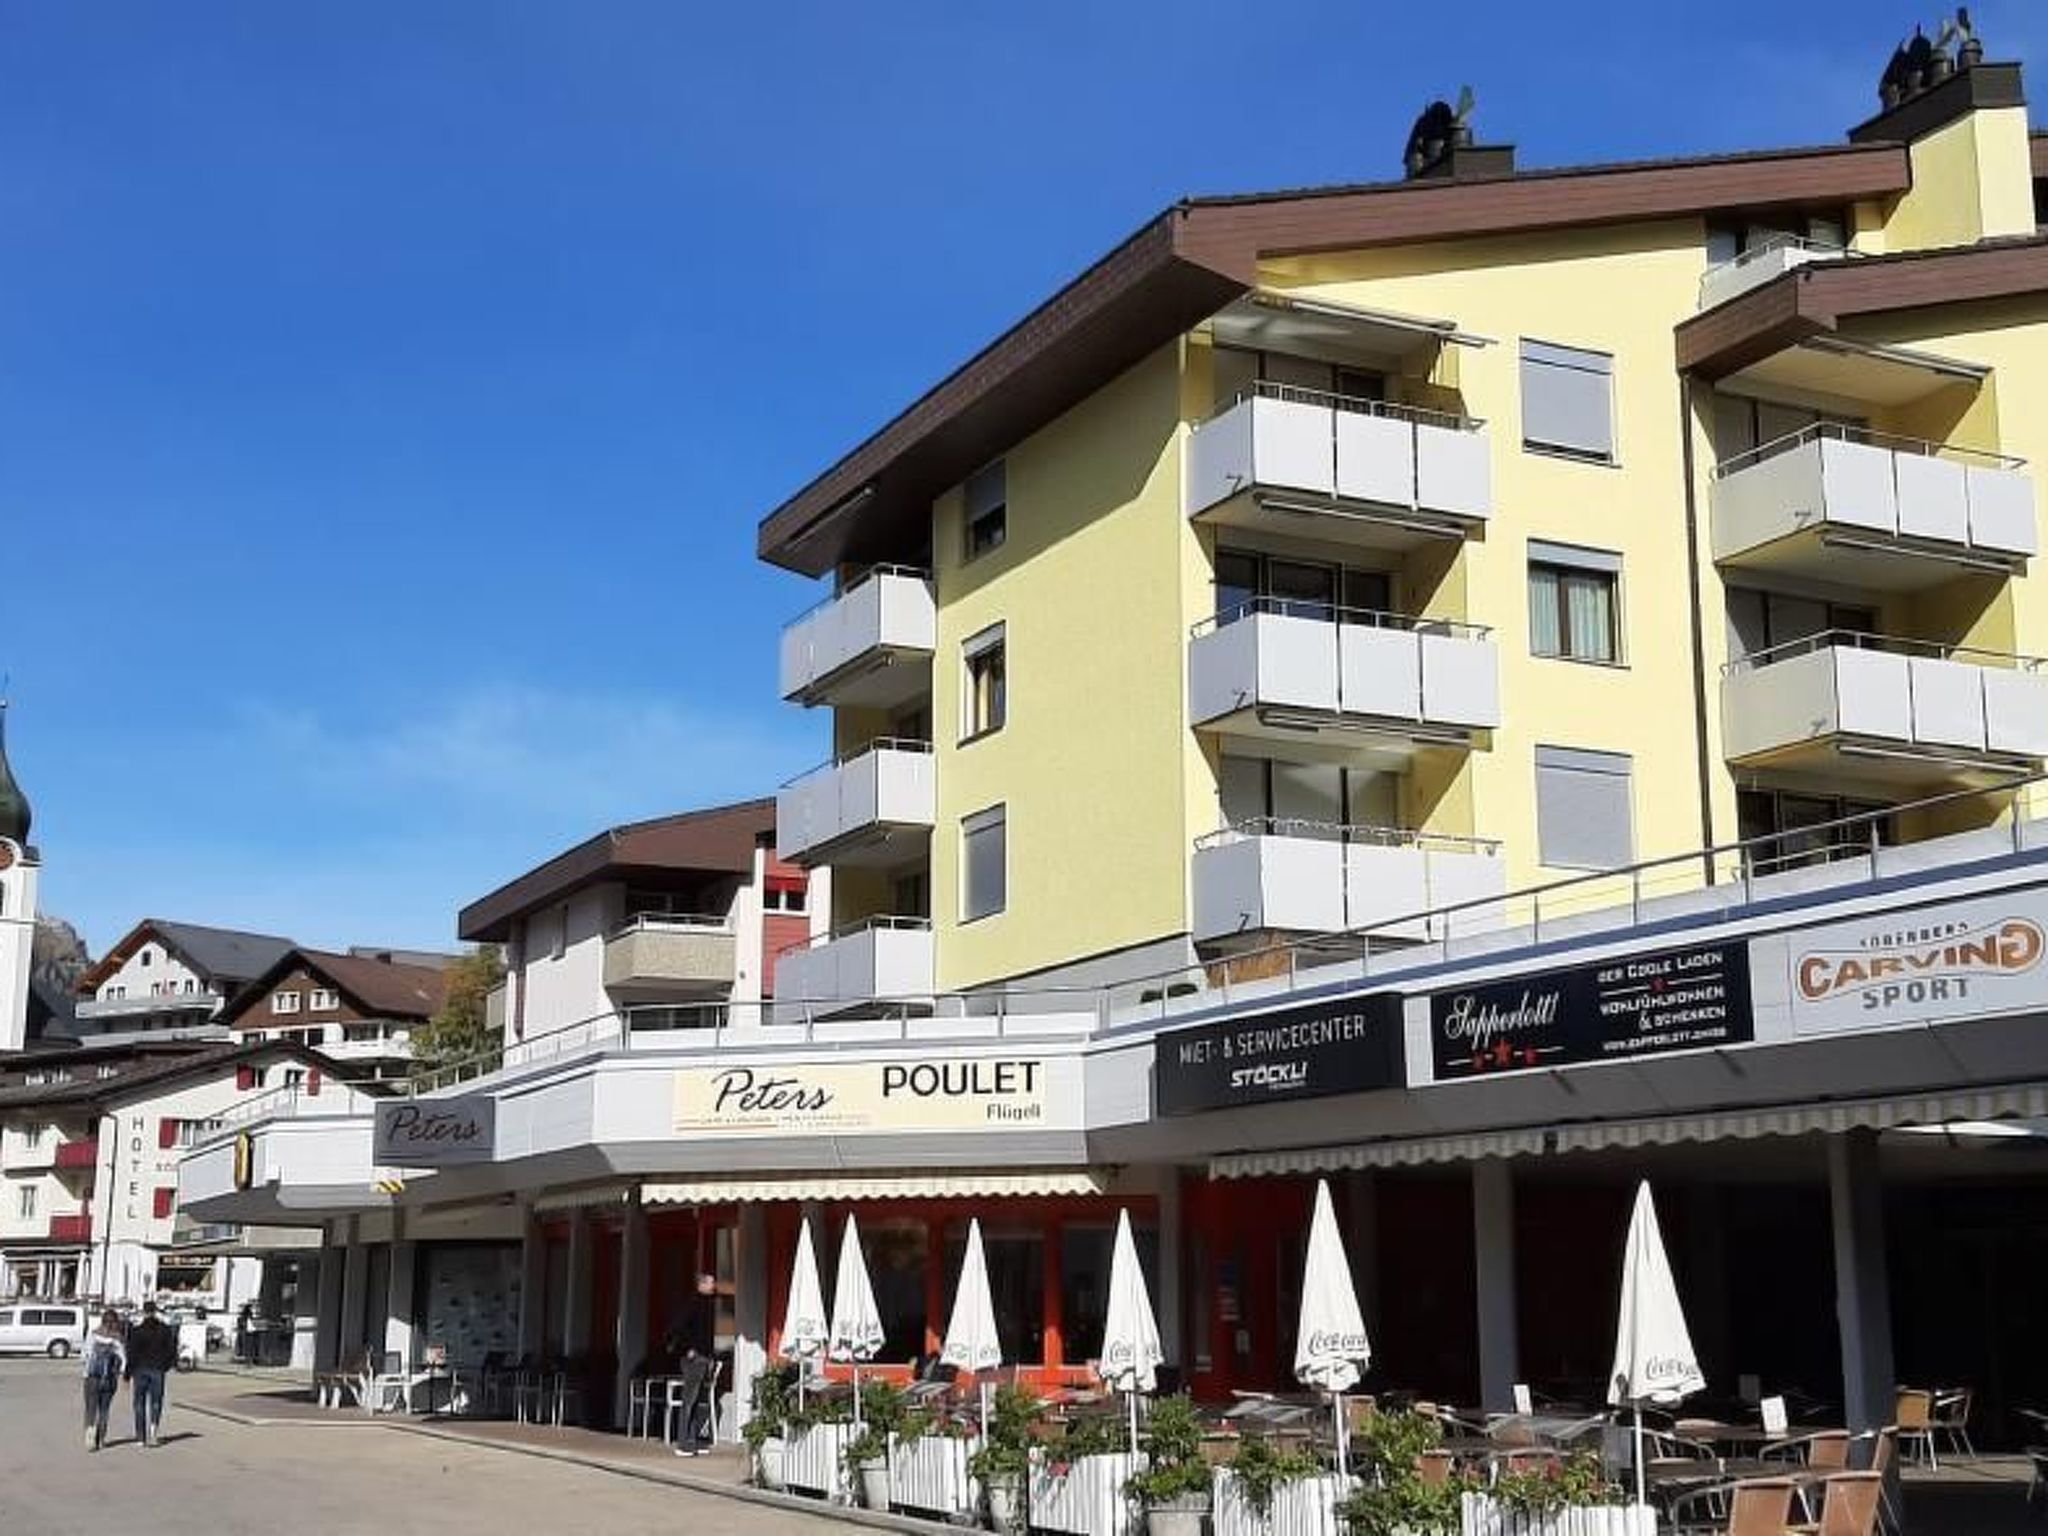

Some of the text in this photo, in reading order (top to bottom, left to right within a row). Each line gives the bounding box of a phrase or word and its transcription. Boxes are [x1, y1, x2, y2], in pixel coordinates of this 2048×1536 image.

[1800, 922, 2041, 998] CARVING
[1862, 978, 1969, 1010] SPORT
[1237, 1014, 1367, 1057] SERVICECENTER
[711, 1068, 834, 1113] Peters
[883, 1061, 1041, 1097] POULET
[385, 1105, 484, 1143] Peters
[127, 1115, 145, 1220] HOTEL
